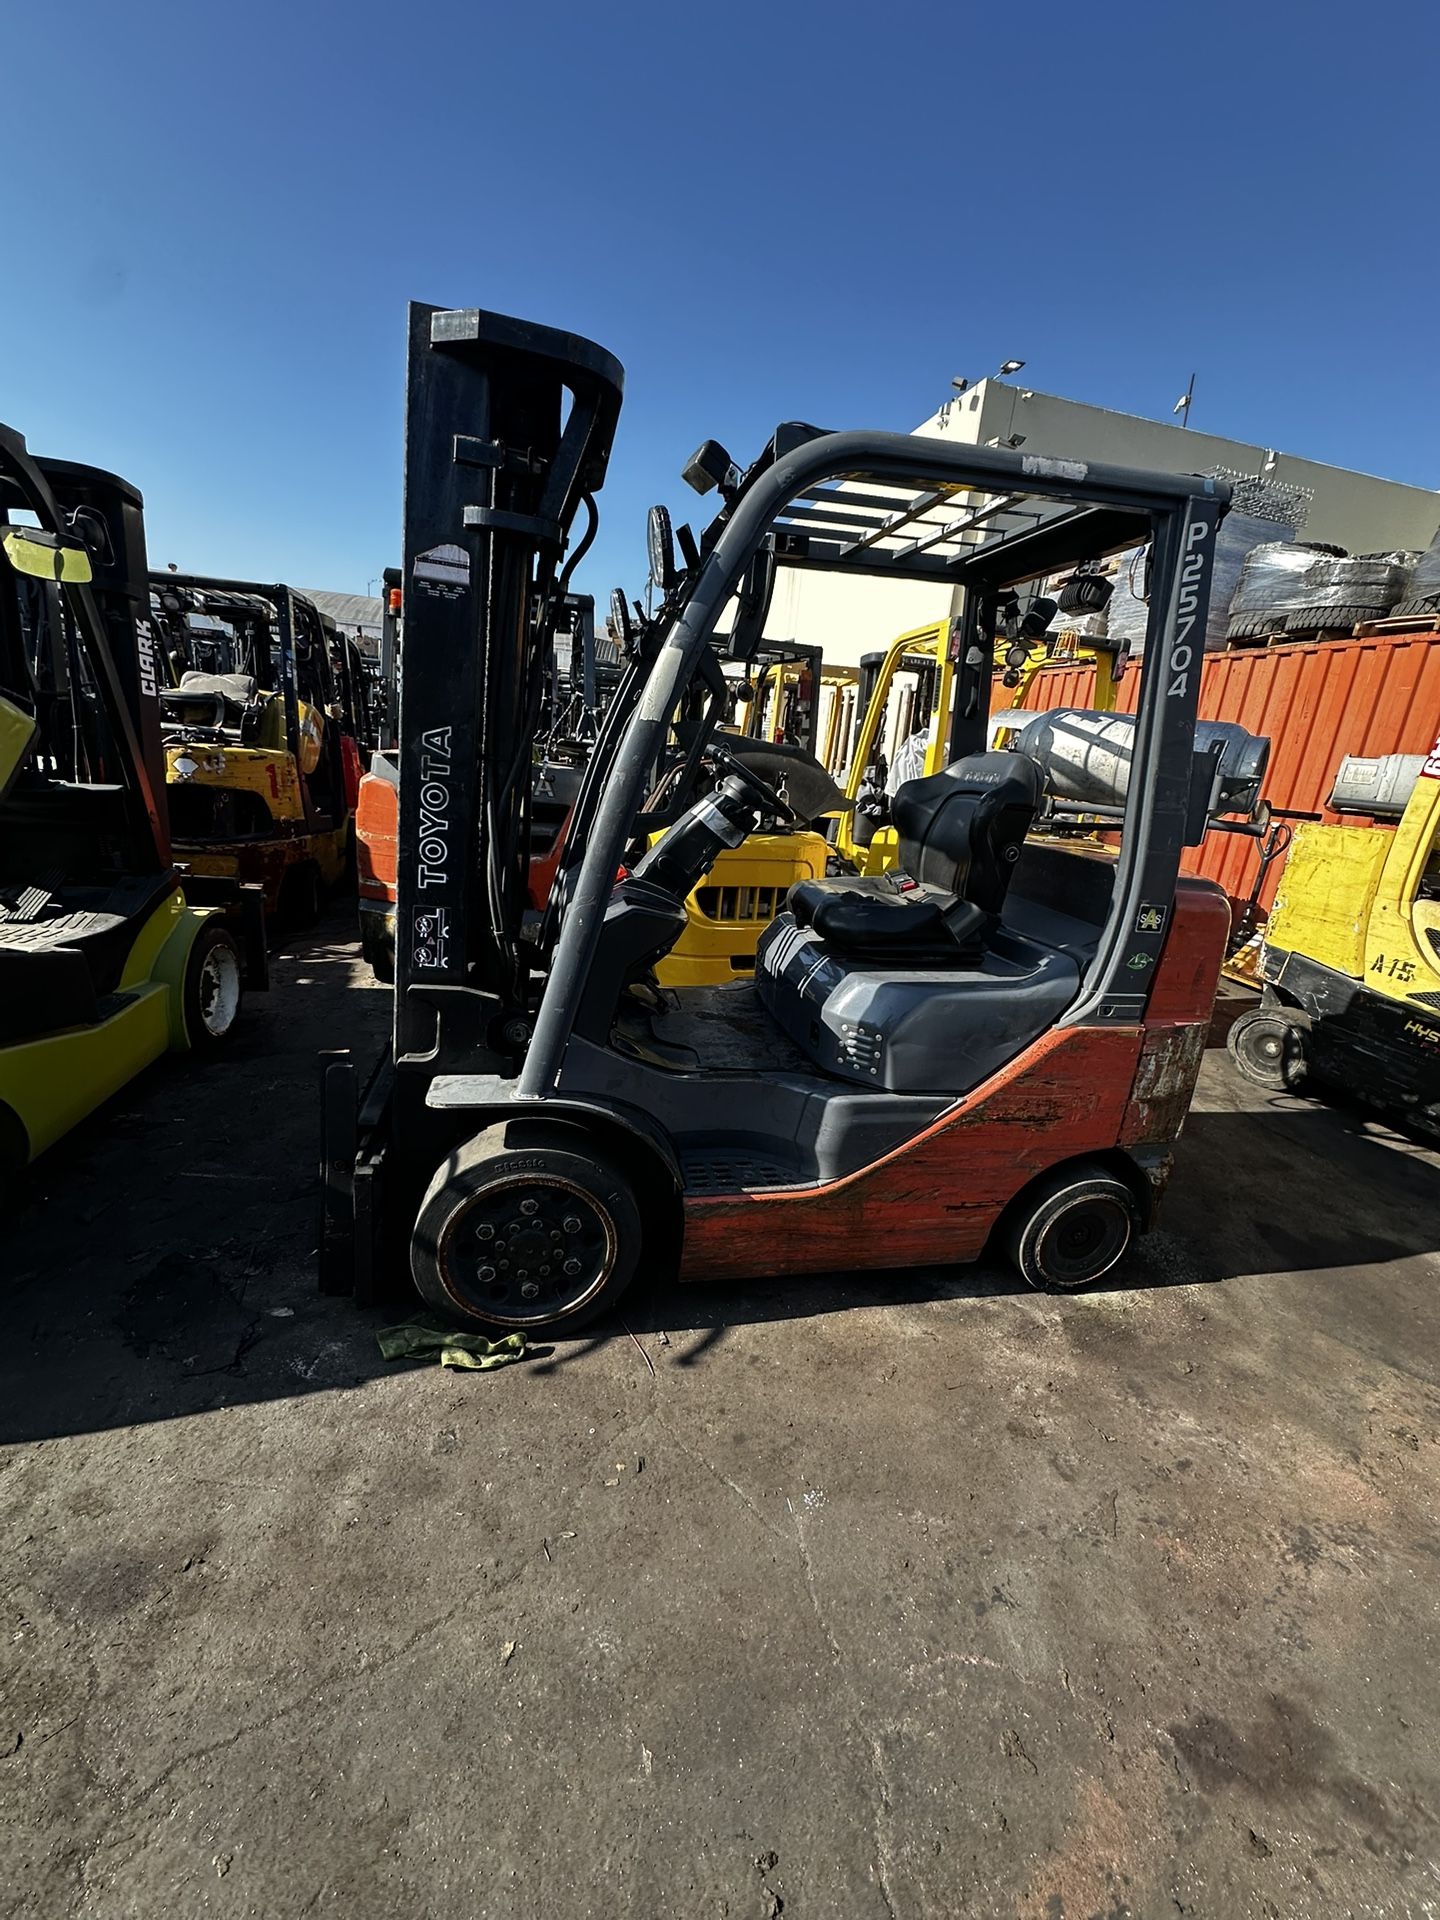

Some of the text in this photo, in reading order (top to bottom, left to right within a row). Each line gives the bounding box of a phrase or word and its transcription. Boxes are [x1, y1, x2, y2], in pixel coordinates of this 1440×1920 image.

[136, 618, 156, 696] CLARK
[1168, 521, 1208, 697] P25704
[418, 726, 451, 888] TOYOTA
